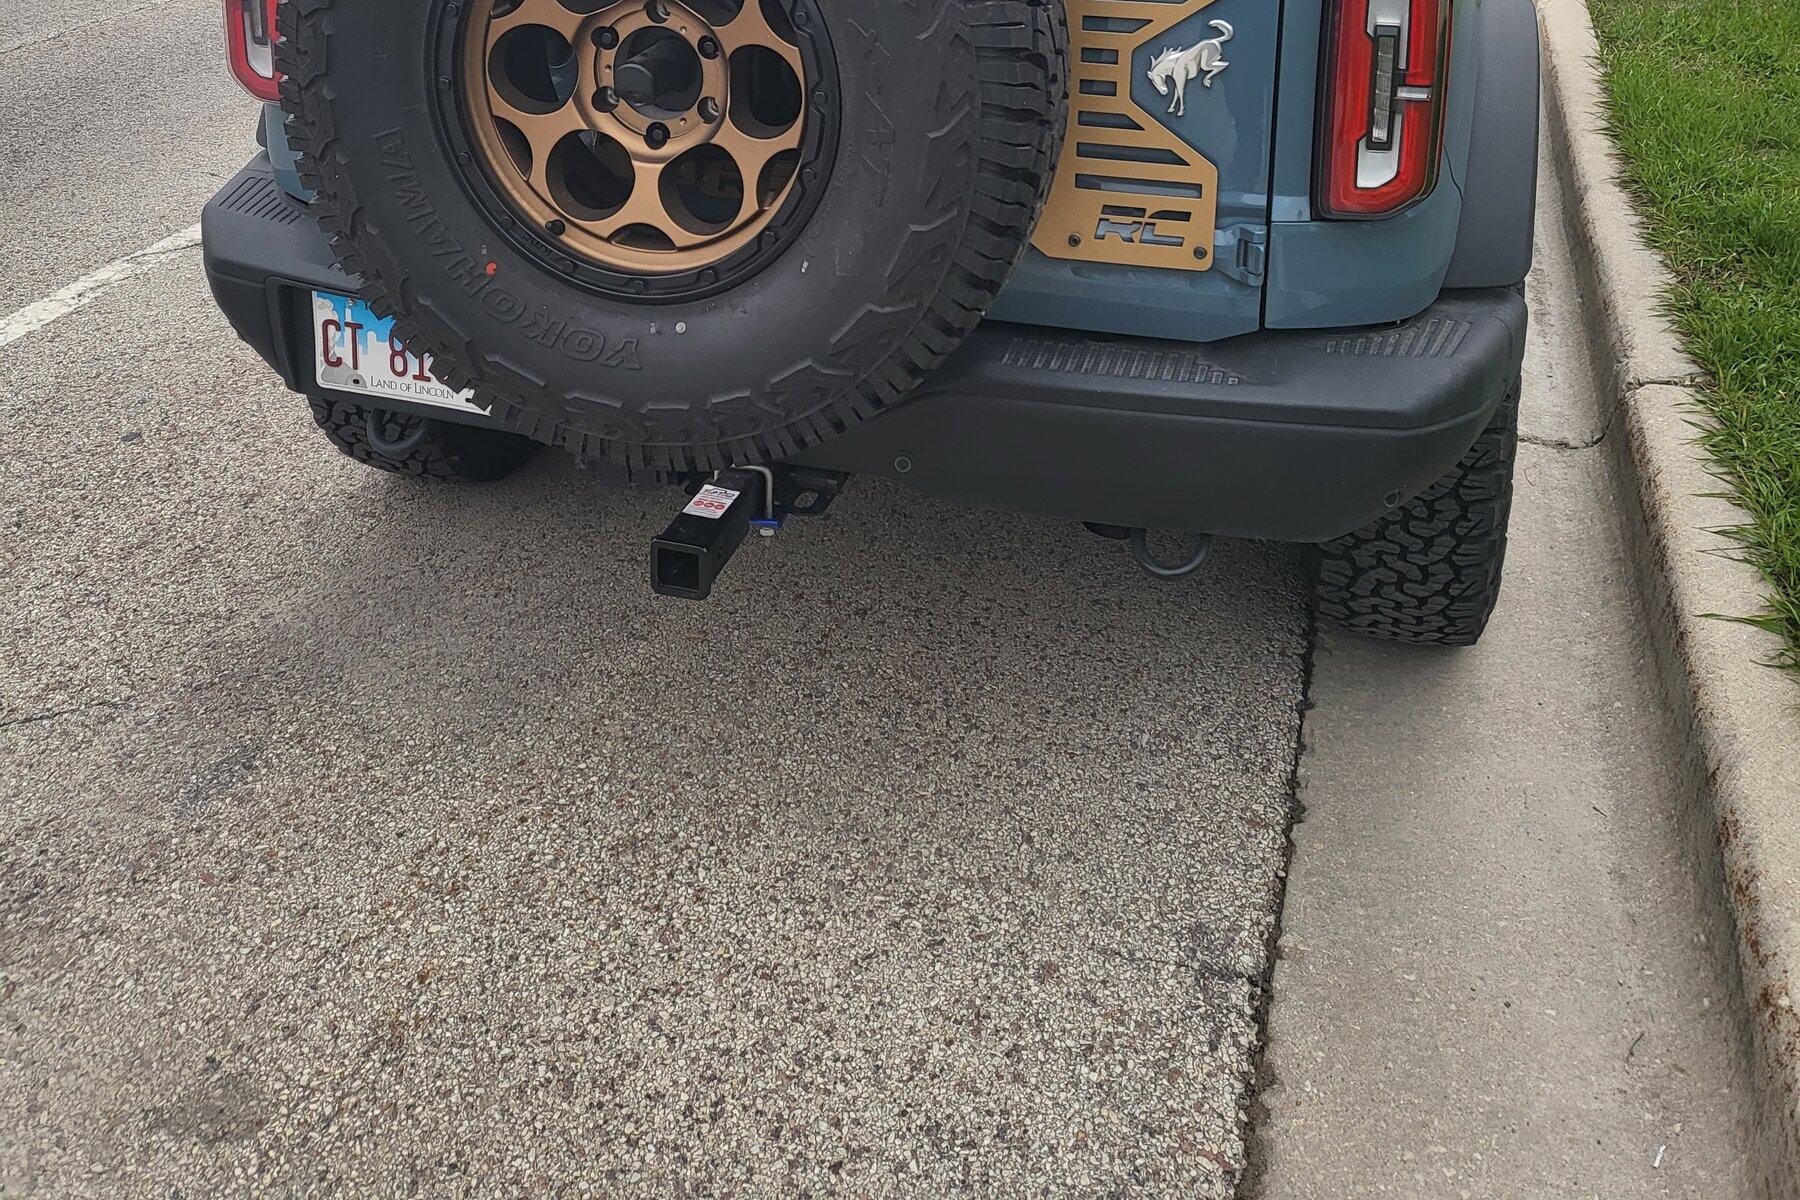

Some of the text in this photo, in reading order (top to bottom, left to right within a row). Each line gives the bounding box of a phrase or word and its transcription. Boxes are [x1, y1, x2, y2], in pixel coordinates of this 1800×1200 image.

[372, 127, 642, 370] YOKOHAMA
[322, 318, 363, 371] CT
[370, 376, 454, 400] LAND OF LINCOLN
